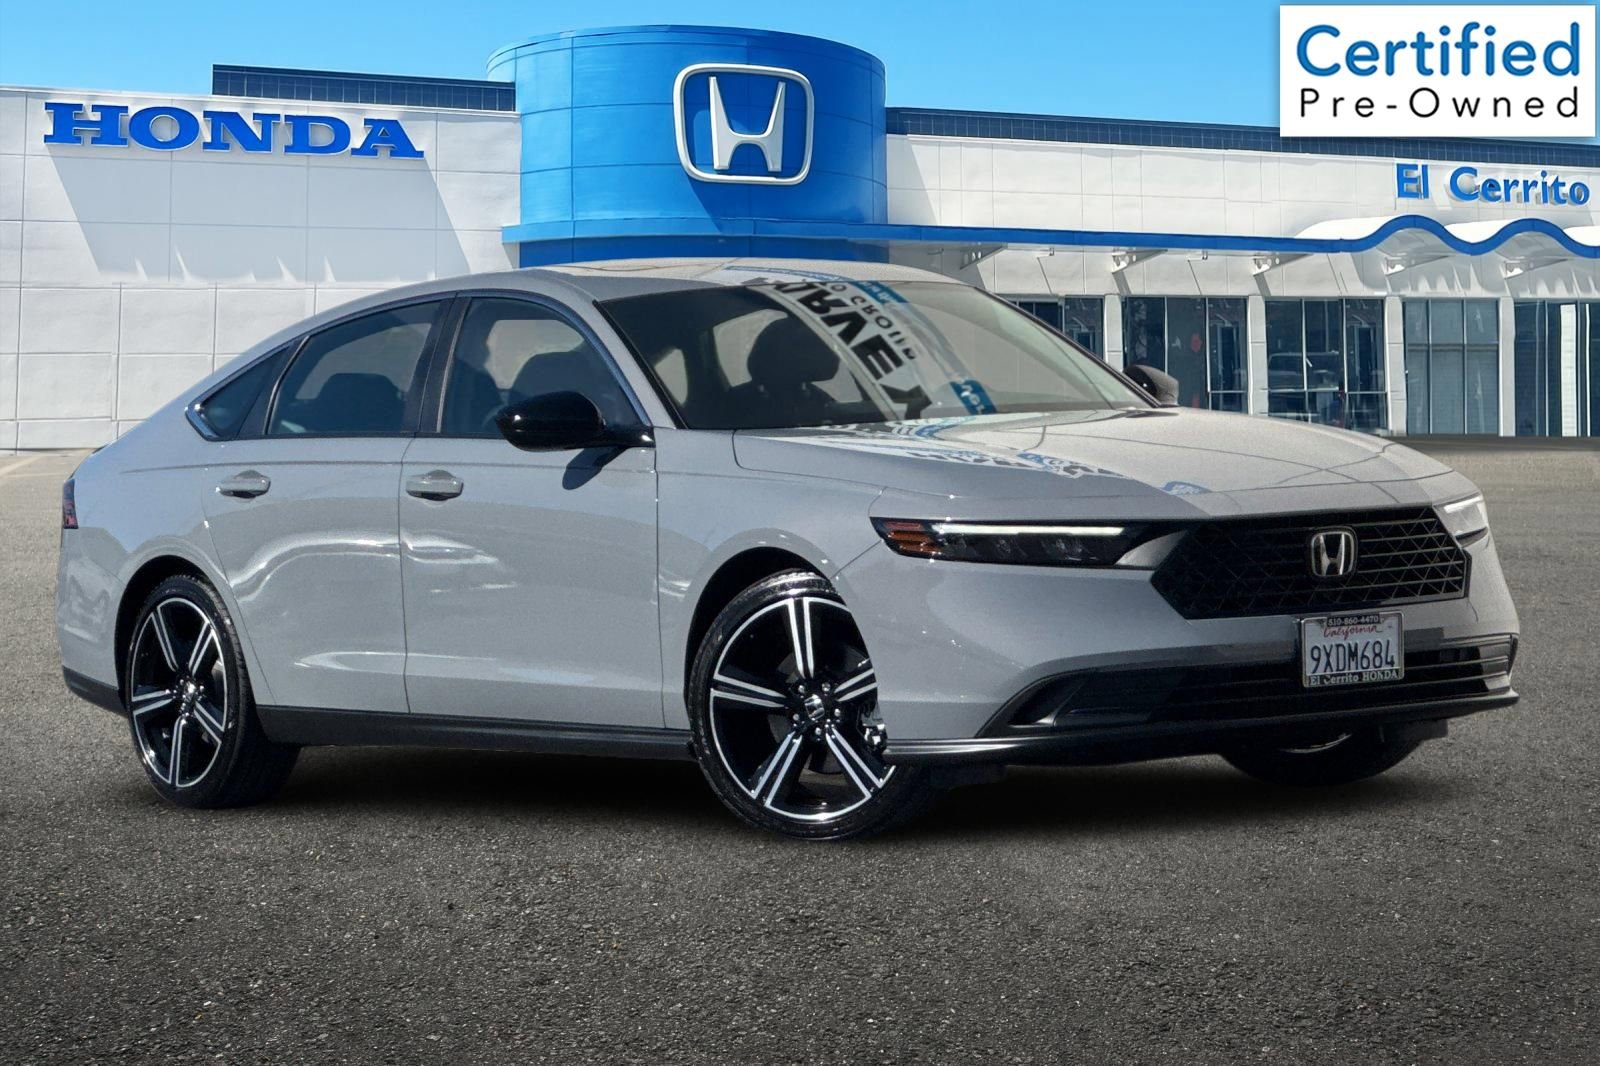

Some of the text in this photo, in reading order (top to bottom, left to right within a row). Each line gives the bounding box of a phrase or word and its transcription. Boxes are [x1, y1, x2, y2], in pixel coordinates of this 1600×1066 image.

[44, 102, 425, 159] HONDA
[1396, 163, 1590, 205] El Cerrito
[1323, 625, 1383, 640] California
[1310, 639, 1396, 674] 9XDM684
[1309, 670, 1398, 686] El Cerrito HONDA
